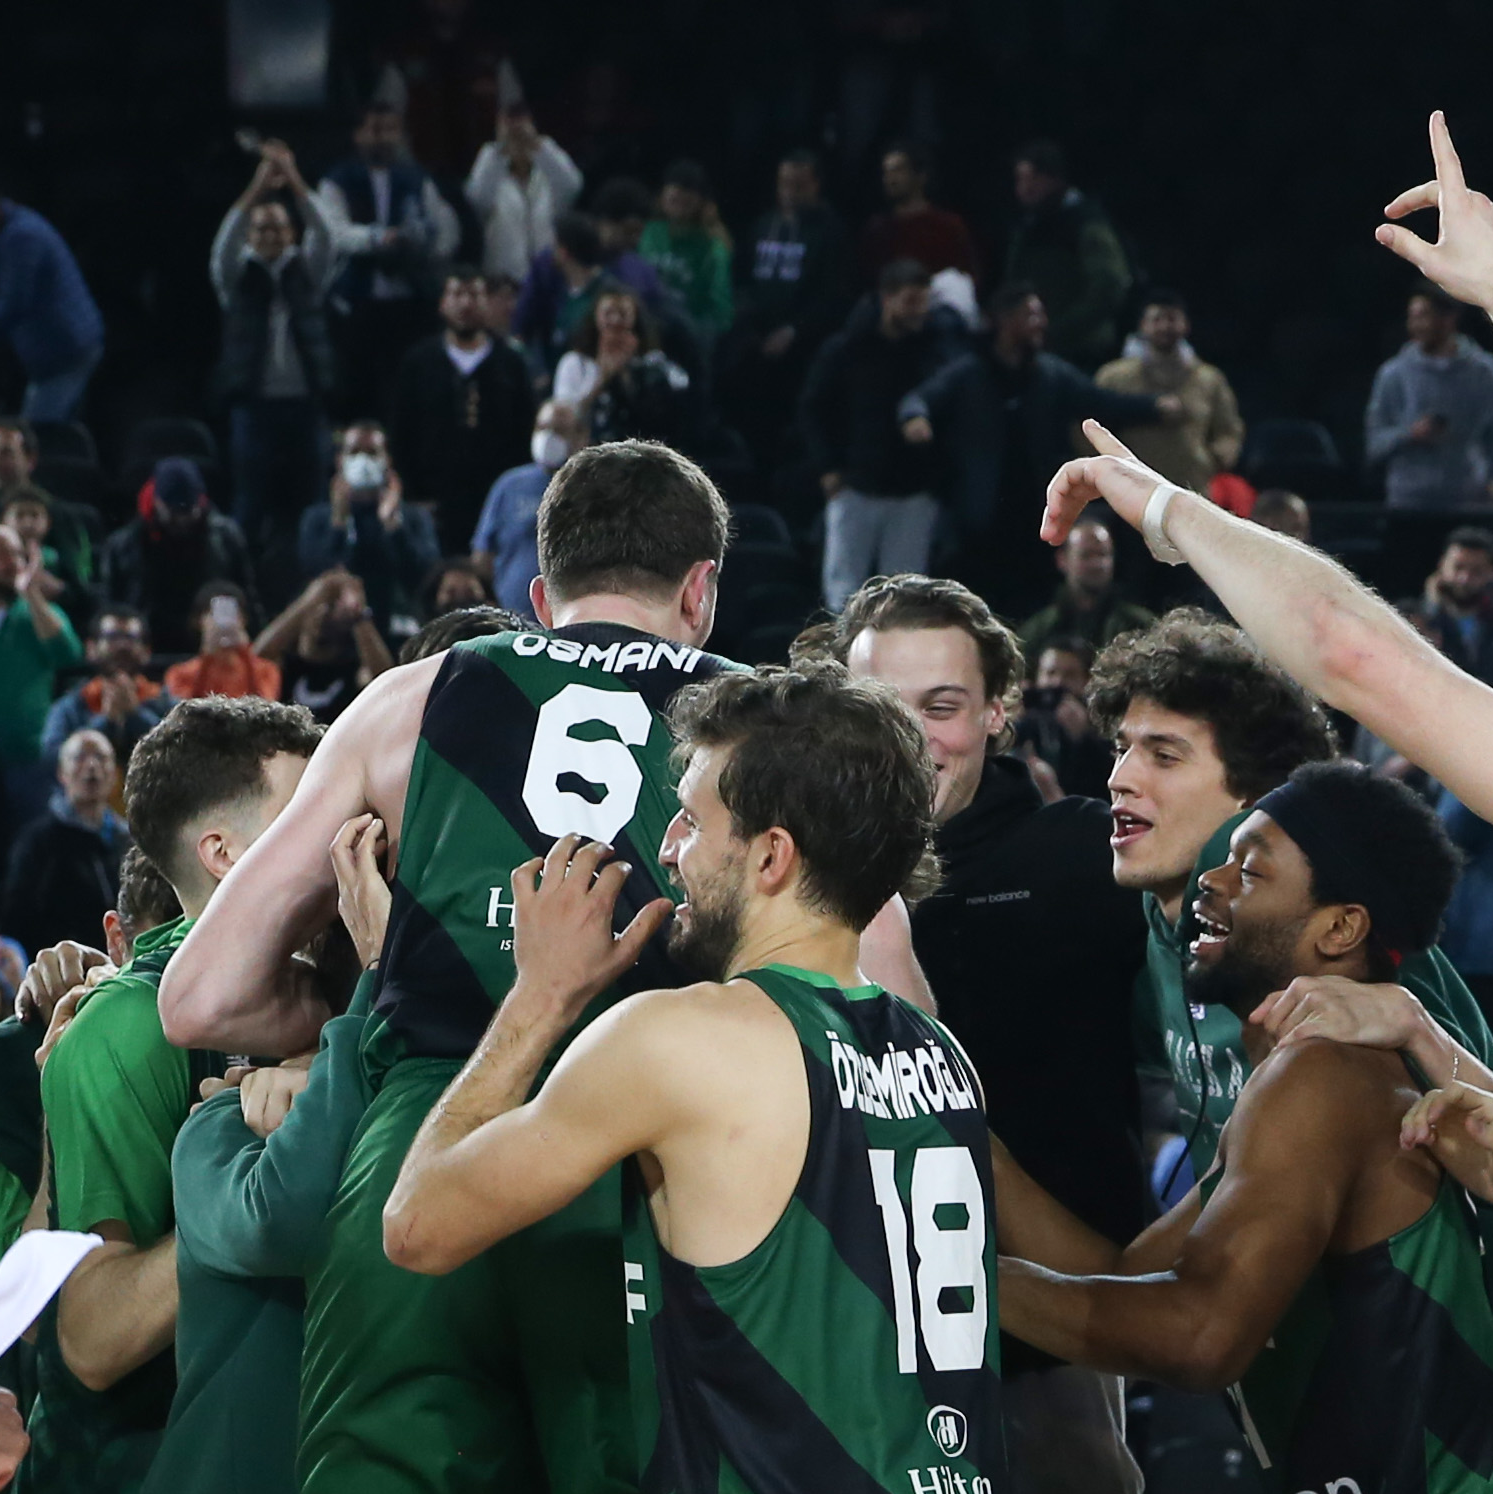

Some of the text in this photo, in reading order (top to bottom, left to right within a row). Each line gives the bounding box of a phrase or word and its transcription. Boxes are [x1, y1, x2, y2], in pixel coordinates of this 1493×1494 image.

[512, 634, 703, 673] OSMANI
[522, 683, 653, 845] 6
[988, 889, 1031, 904] balance
[868, 1146, 987, 1375] 18
